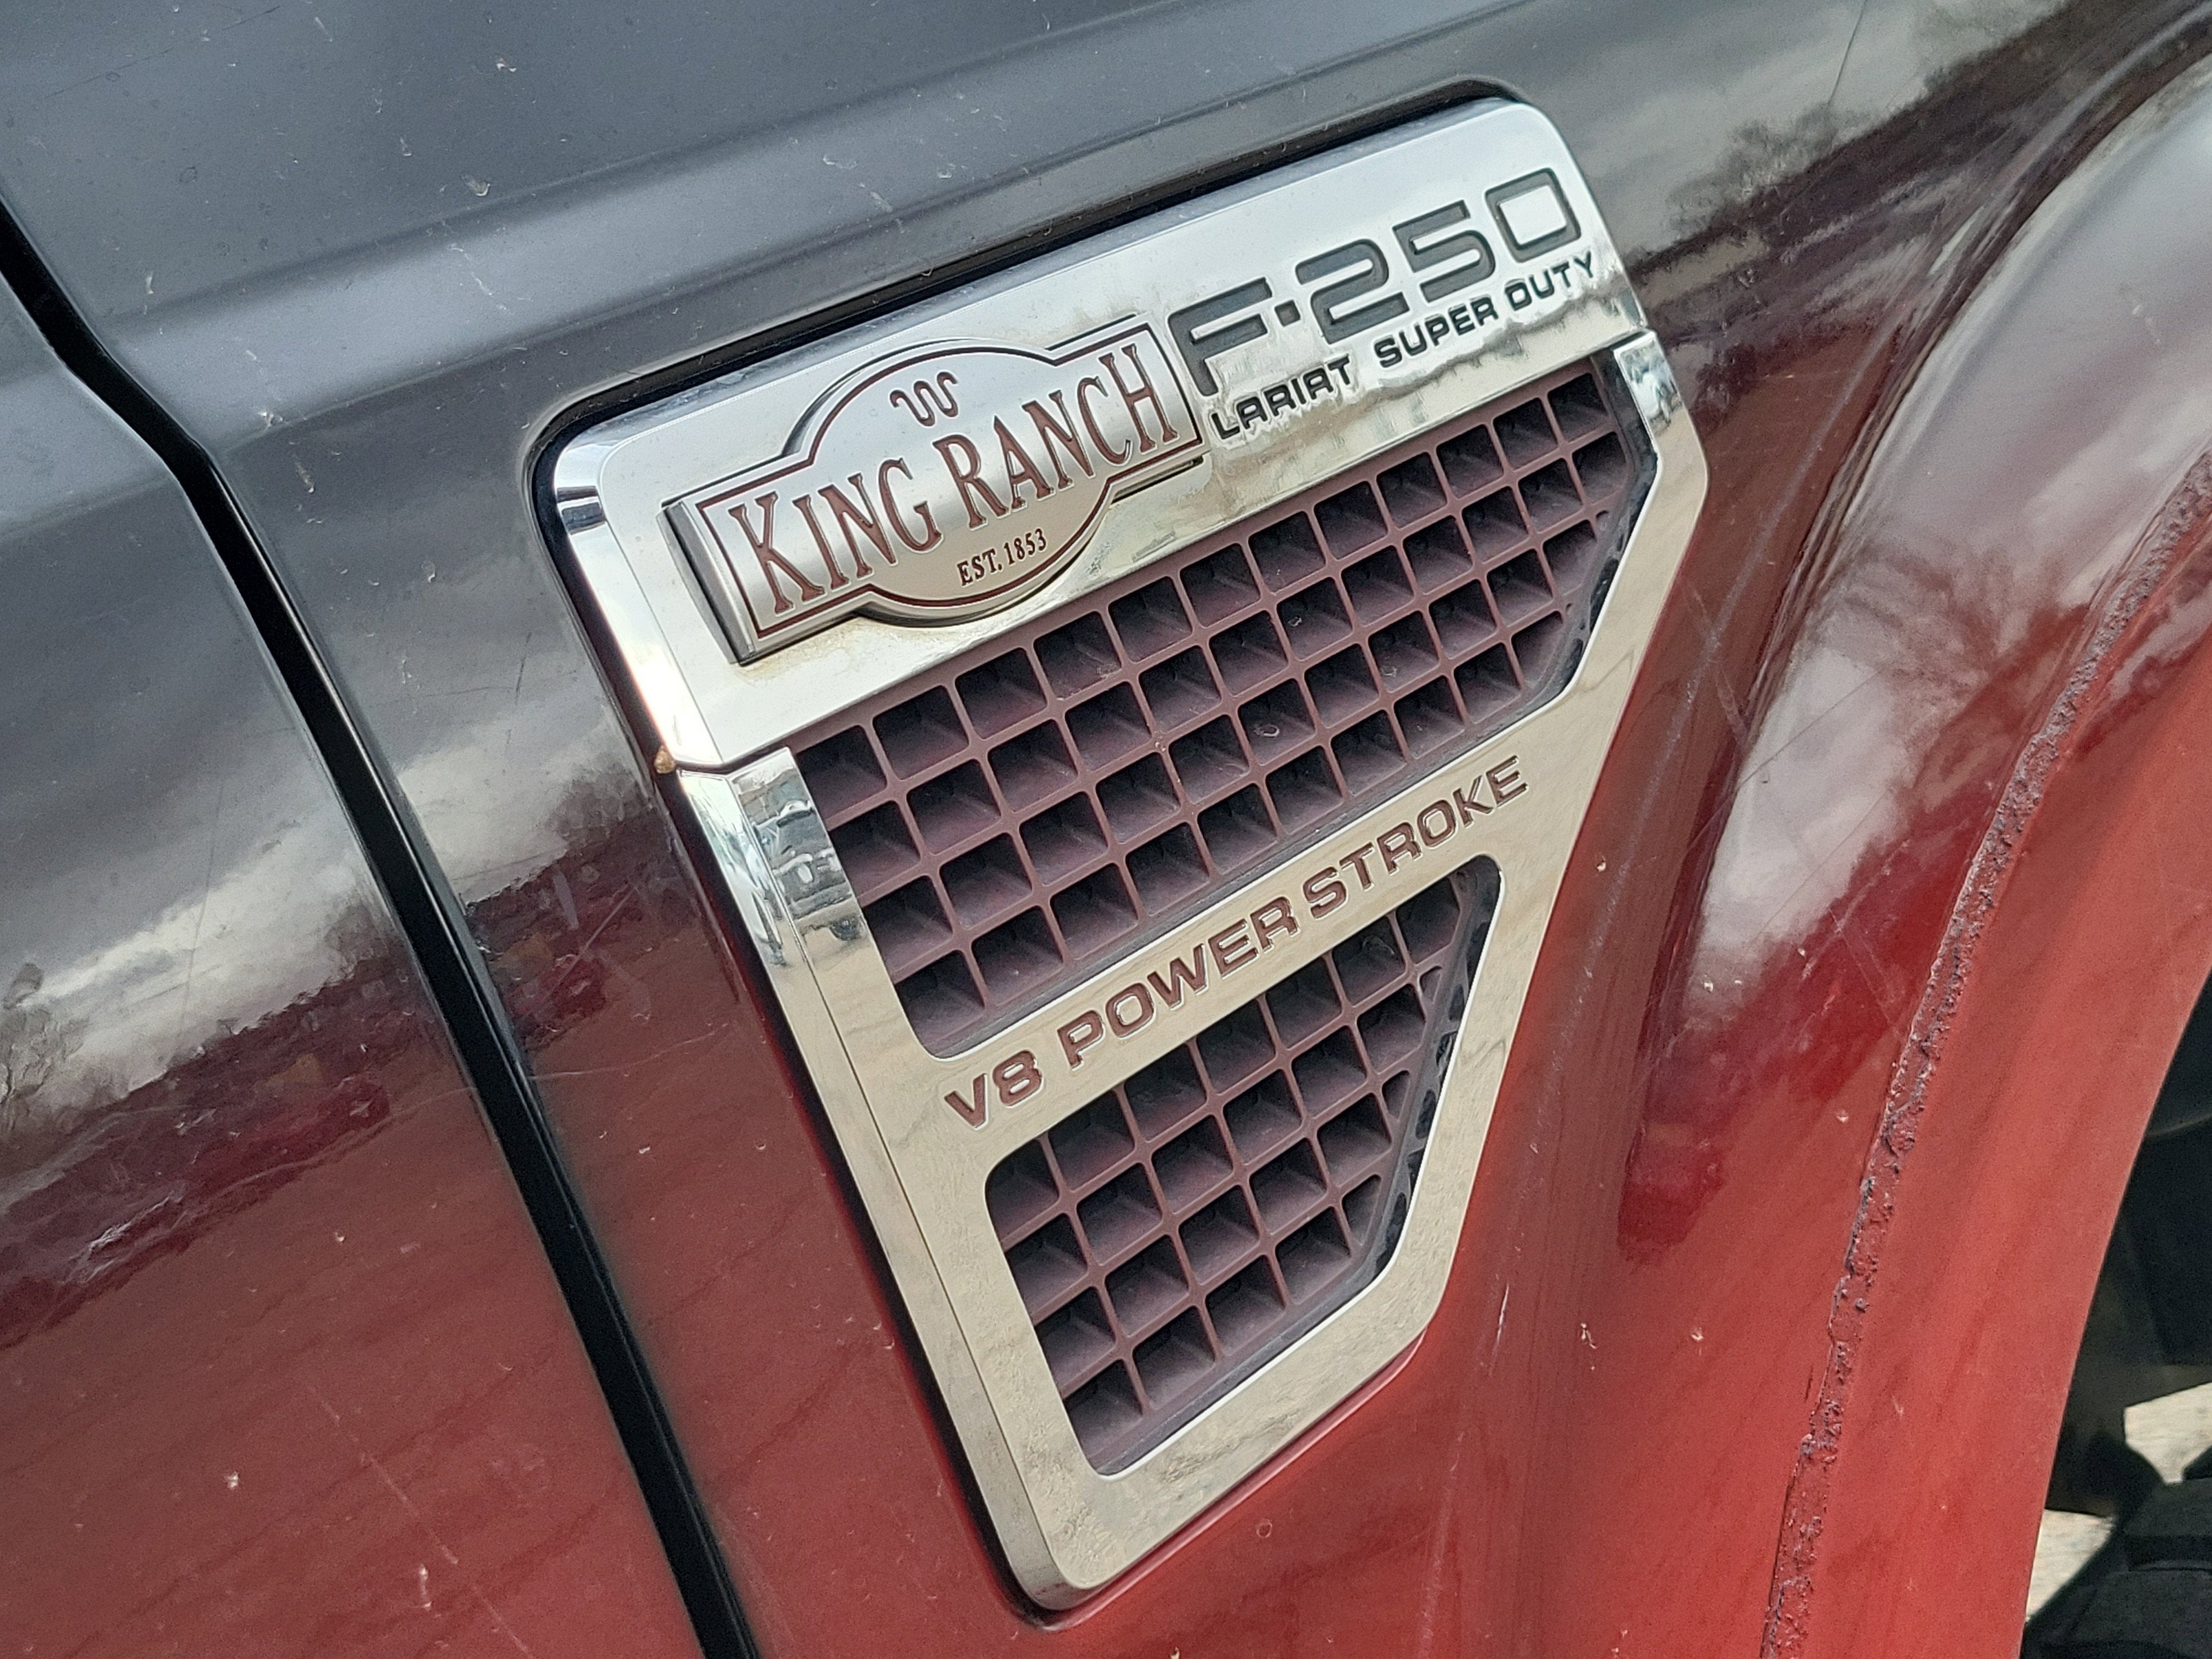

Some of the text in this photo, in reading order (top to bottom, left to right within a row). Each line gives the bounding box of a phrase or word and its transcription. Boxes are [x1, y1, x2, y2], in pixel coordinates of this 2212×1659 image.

[1211, 251, 1594, 440] LARIAT SUPER DUTY
[728, 343, 1179, 615] KING RANCH
[956, 527, 1047, 587] EST. 1853
[943, 755, 1528, 1129] V8 POWER STROKE
